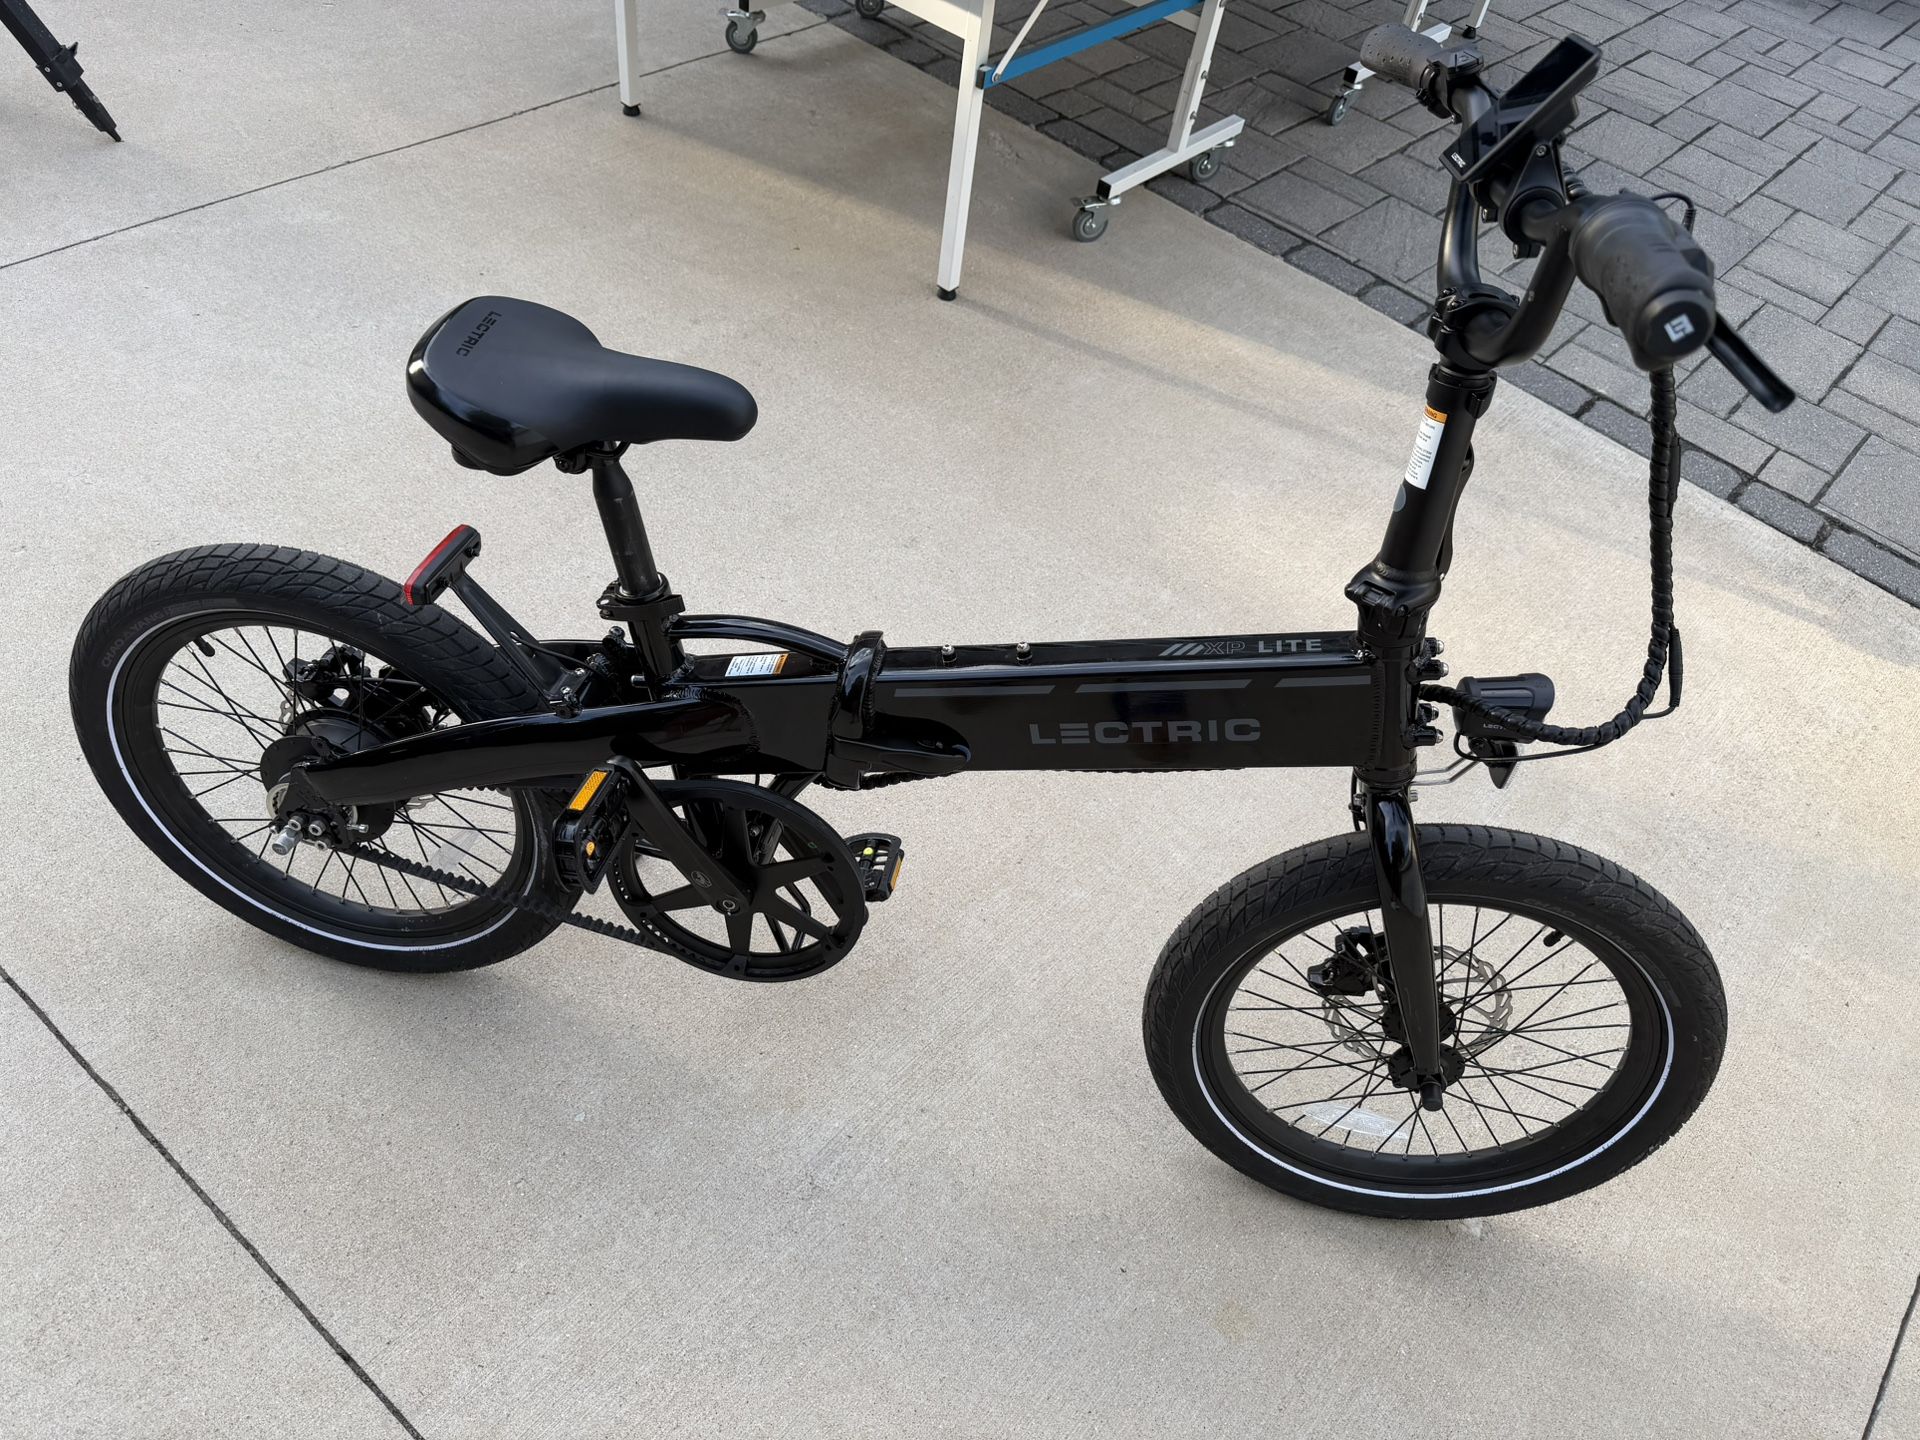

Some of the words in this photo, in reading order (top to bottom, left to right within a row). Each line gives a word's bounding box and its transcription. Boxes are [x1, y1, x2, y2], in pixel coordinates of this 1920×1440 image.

[456, 311, 502, 357] LECTRIC
[1202, 640, 1246, 656] XP
[1258, 638, 1322, 653] LITE
[1028, 718, 1261, 745] LECTRIC
